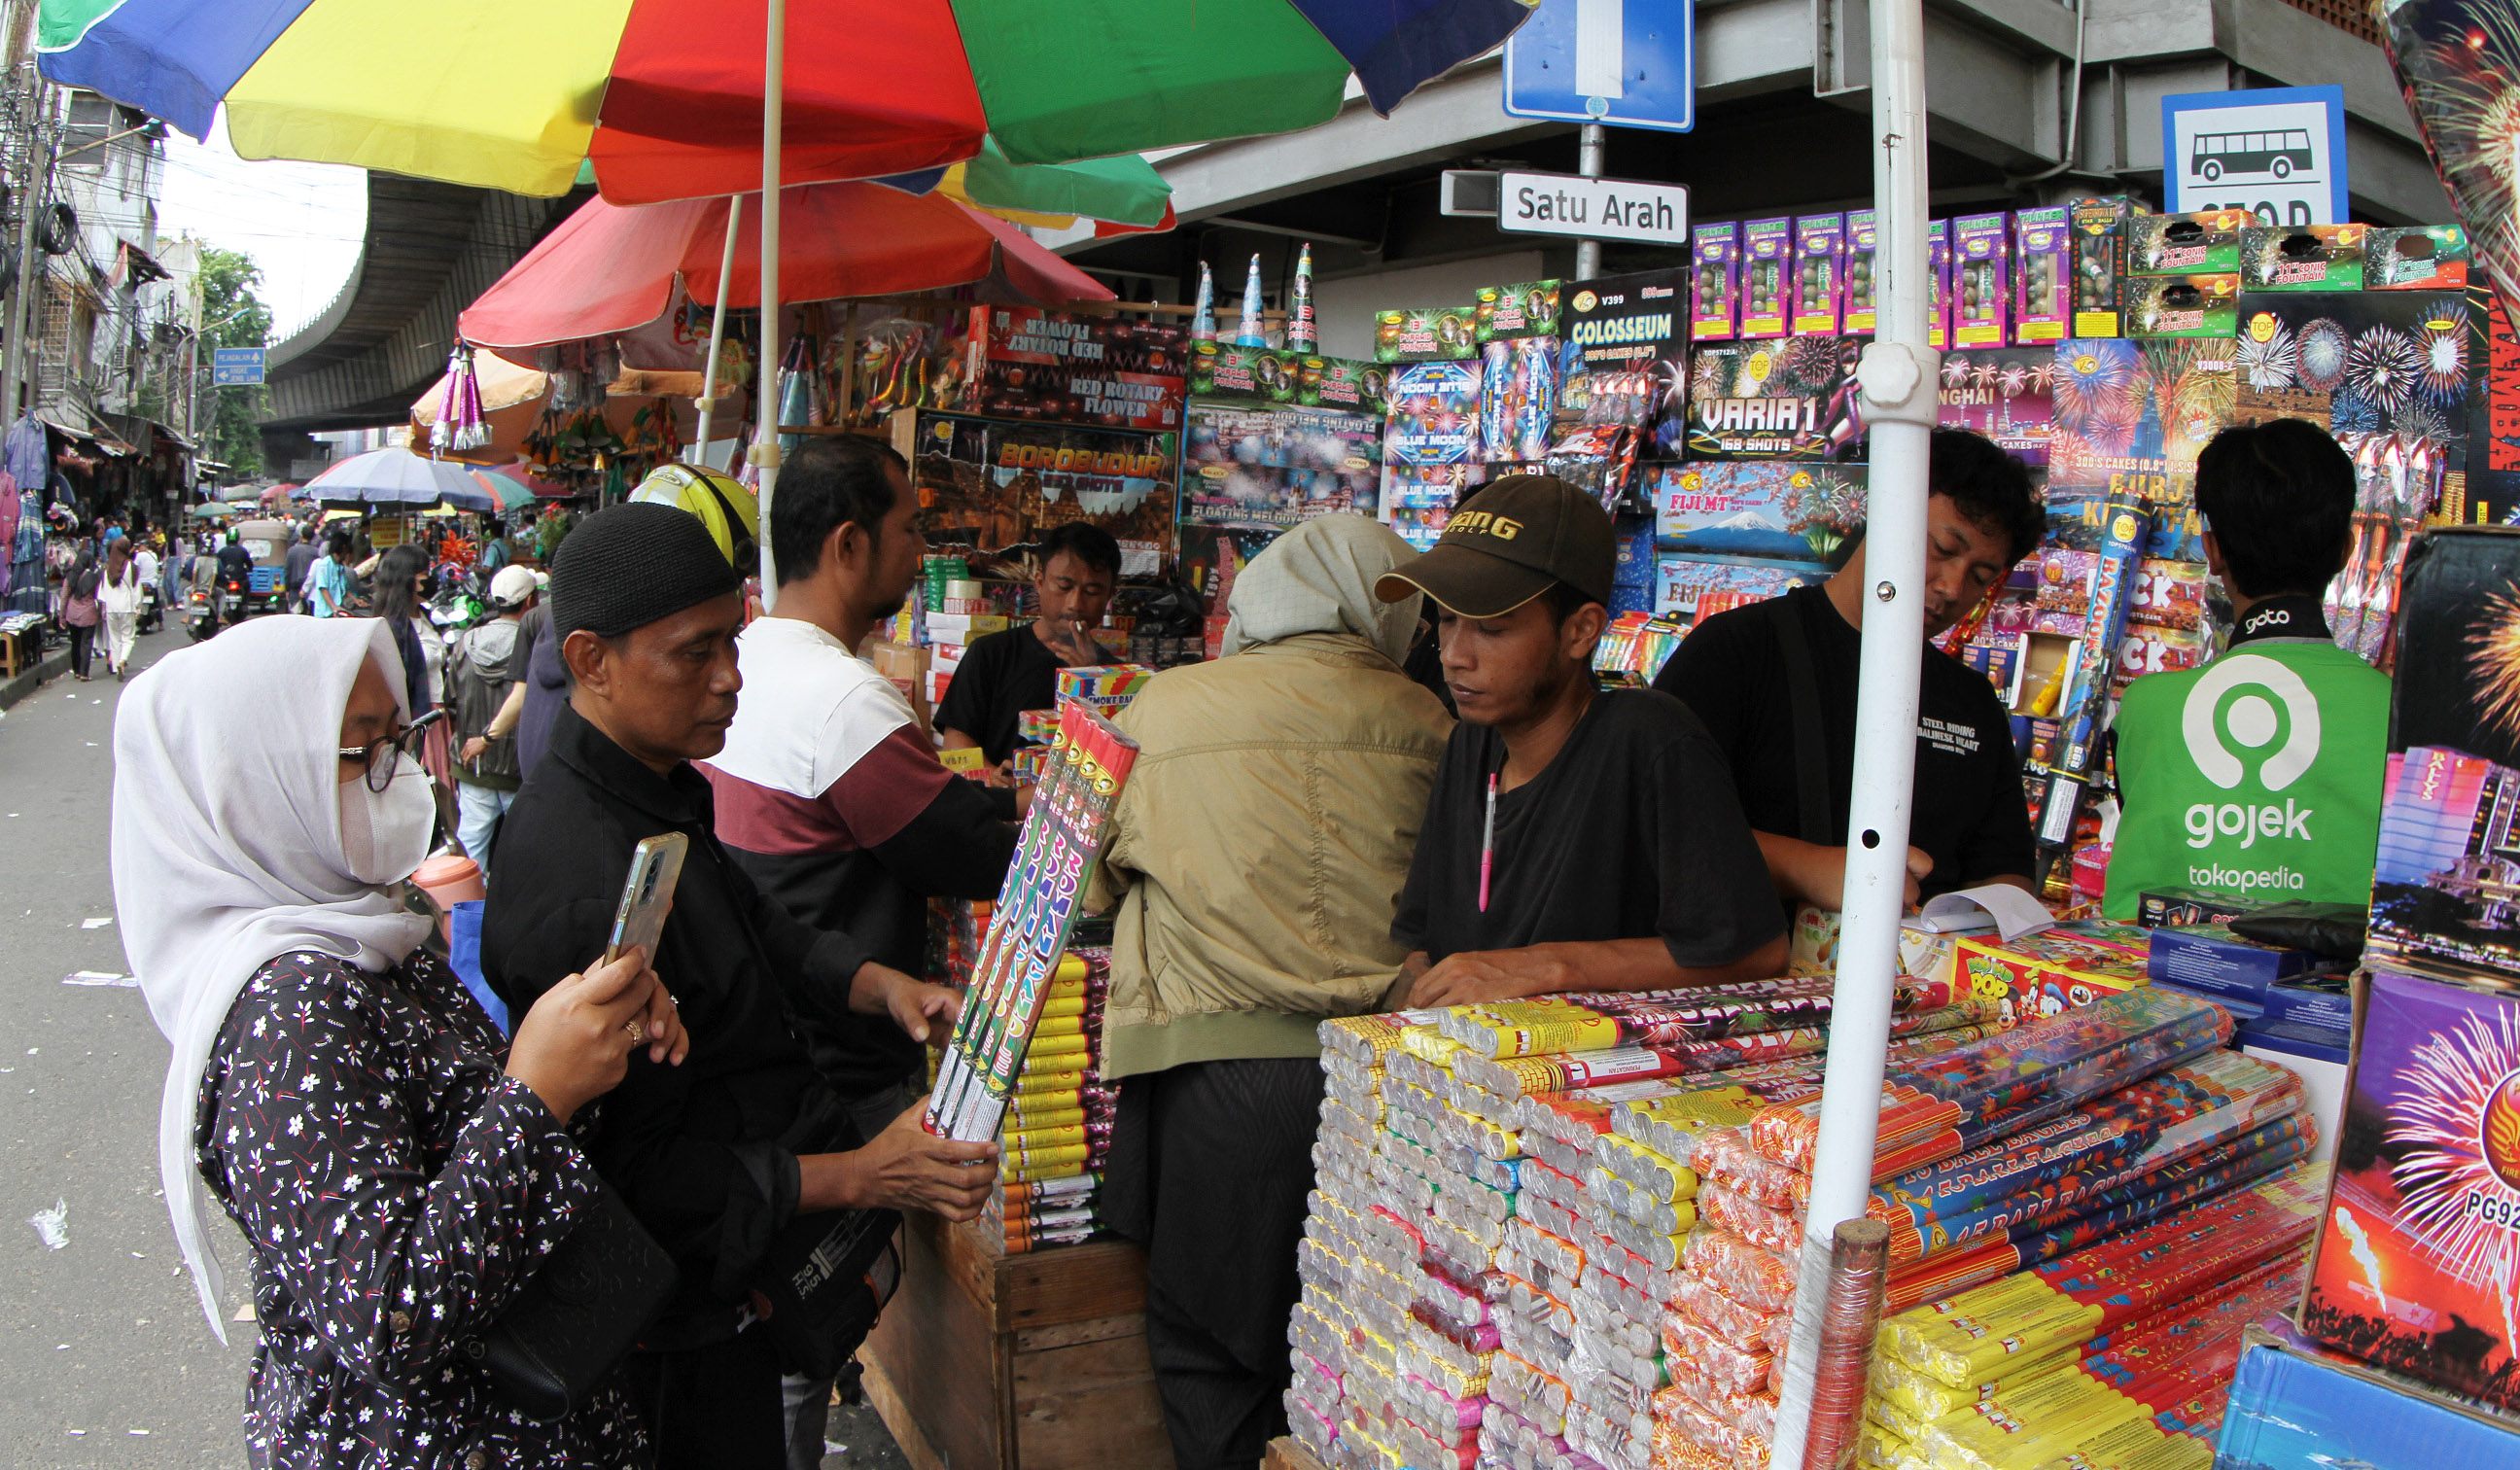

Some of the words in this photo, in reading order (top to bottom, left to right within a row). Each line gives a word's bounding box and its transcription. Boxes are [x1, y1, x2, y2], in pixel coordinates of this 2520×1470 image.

[1517, 187, 1588, 224] Satu
[1601, 194, 1674, 230] Arah
[1799, 217, 1839, 229] THUNDER
[1849, 213, 1875, 225] THUN
[1956, 217, 2002, 230] THUNDER
[2017, 210, 2065, 223] THUNDER
[1696, 226, 1733, 237] THUNDER
[1746, 222, 1786, 232] THUNDER
[2180, 246, 2207, 257] CONIC
[2161, 255, 2206, 268] FOUNTAIN
[2297, 261, 2327, 272] CONIC
[2410, 259, 2435, 270] CONIC
[2275, 270, 2326, 284] FOUNTAIN
[2395, 268, 2436, 282] FOUNTAIN
[1601, 296, 1624, 306] V399
[1493, 309, 1522, 321] PYRAMID
[2177, 310, 2203, 321] CONIC
[1026, 319, 1090, 340] FLOWER
[1288, 322, 1316, 332] PYRA
[1492, 317, 1525, 332] FOUNTAIN
[1572, 313, 1671, 345] COLOSSEUM
[2157, 319, 2202, 332] FOUNTAIN
[2253, 321, 2273, 332] TOP
[1288, 332, 1317, 341] FOUN
[1399, 333, 1432, 343] PYRAMID
[1008, 335, 1068, 356] ROTARY
[1072, 342, 1104, 360] RED
[1399, 341, 1437, 353] FOUNTAIN
[1585, 348, 1606, 361] 399'S
[1607, 347, 1633, 360] CAKES
[1750, 360, 1769, 372] TOP
[2198, 360, 2235, 371] V3008-2
[1214, 367, 1249, 379] PYRAMID
[1494, 355, 1504, 395] BLUE
[1529, 352, 1539, 401] MOON
[1069, 378, 1102, 395] RED
[1104, 380, 1166, 402] ROTARY
[1213, 377, 1254, 392] FOUNTAIN
[1320, 380, 1354, 392] PYRAMID
[1400, 382, 1435, 394] MOON
[1439, 381, 1470, 392] BLUE
[1320, 390, 1359, 404] FOUNTAIN
[1938, 388, 1995, 405] NGHAI
[1084, 397, 1148, 418] FLOWER
[1702, 397, 1799, 432] VARIA
[1802, 397, 1816, 432] 1
[1272, 409, 1319, 427] MELODY
[1322, 414, 1377, 434] FLOATING
[1492, 400, 1502, 447] MOON
[2189, 419, 2204, 430] 300
[1527, 405, 1537, 446] BLUE
[1395, 435, 1426, 445] BLUE
[1429, 435, 1466, 445] MOON
[1721, 438, 1743, 452] 168
[1746, 438, 1791, 452] SHOTS
[2001, 439, 2032, 450] CAKES
[999, 442, 1163, 477] BOROBUDUR
[2075, 455, 2104, 469] 300'S
[2105, 456, 2137, 470] CAKES
[1076, 476, 1125, 494] SHOTS
[1398, 485, 1423, 495] BLUE
[1426, 485, 1454, 495] MOON
[1670, 494, 1701, 510] FIJI
[1704, 495, 1729, 511] MT
[1192, 506, 1249, 522] FLOATING
[1252, 509, 1299, 525] MELODY
[1398, 529, 1423, 539] BLUE
[2116, 521, 2136, 533] TOP
[2080, 555, 2120, 671] BAZOOKA
[2245, 609, 2291, 635] goto
[1089, 696, 1117, 705] SMOKE
[1922, 716, 1945, 730] STEEL
[1946, 722, 1976, 739] RIDING
[1917, 726, 1954, 745] BALINESE
[1955, 735, 1980, 752] HEART
[2185, 797, 2313, 850] gojek
[2188, 862, 2305, 893] tokopedia
[1037, 847, 1085, 959] ROMAN
[1971, 972, 2009, 998] POP
[993, 955, 1048, 1078] CANDLE
[1608, 1064, 1641, 1075] PERINGATAN
[1904, 1165, 1932, 1184] 15
[1937, 1140, 2003, 1174] BALL
[2005, 1113, 2091, 1151] EAGLES
[803, 1264, 822, 1288] 95
[2052, 1323, 2077, 1338] Peringatan
